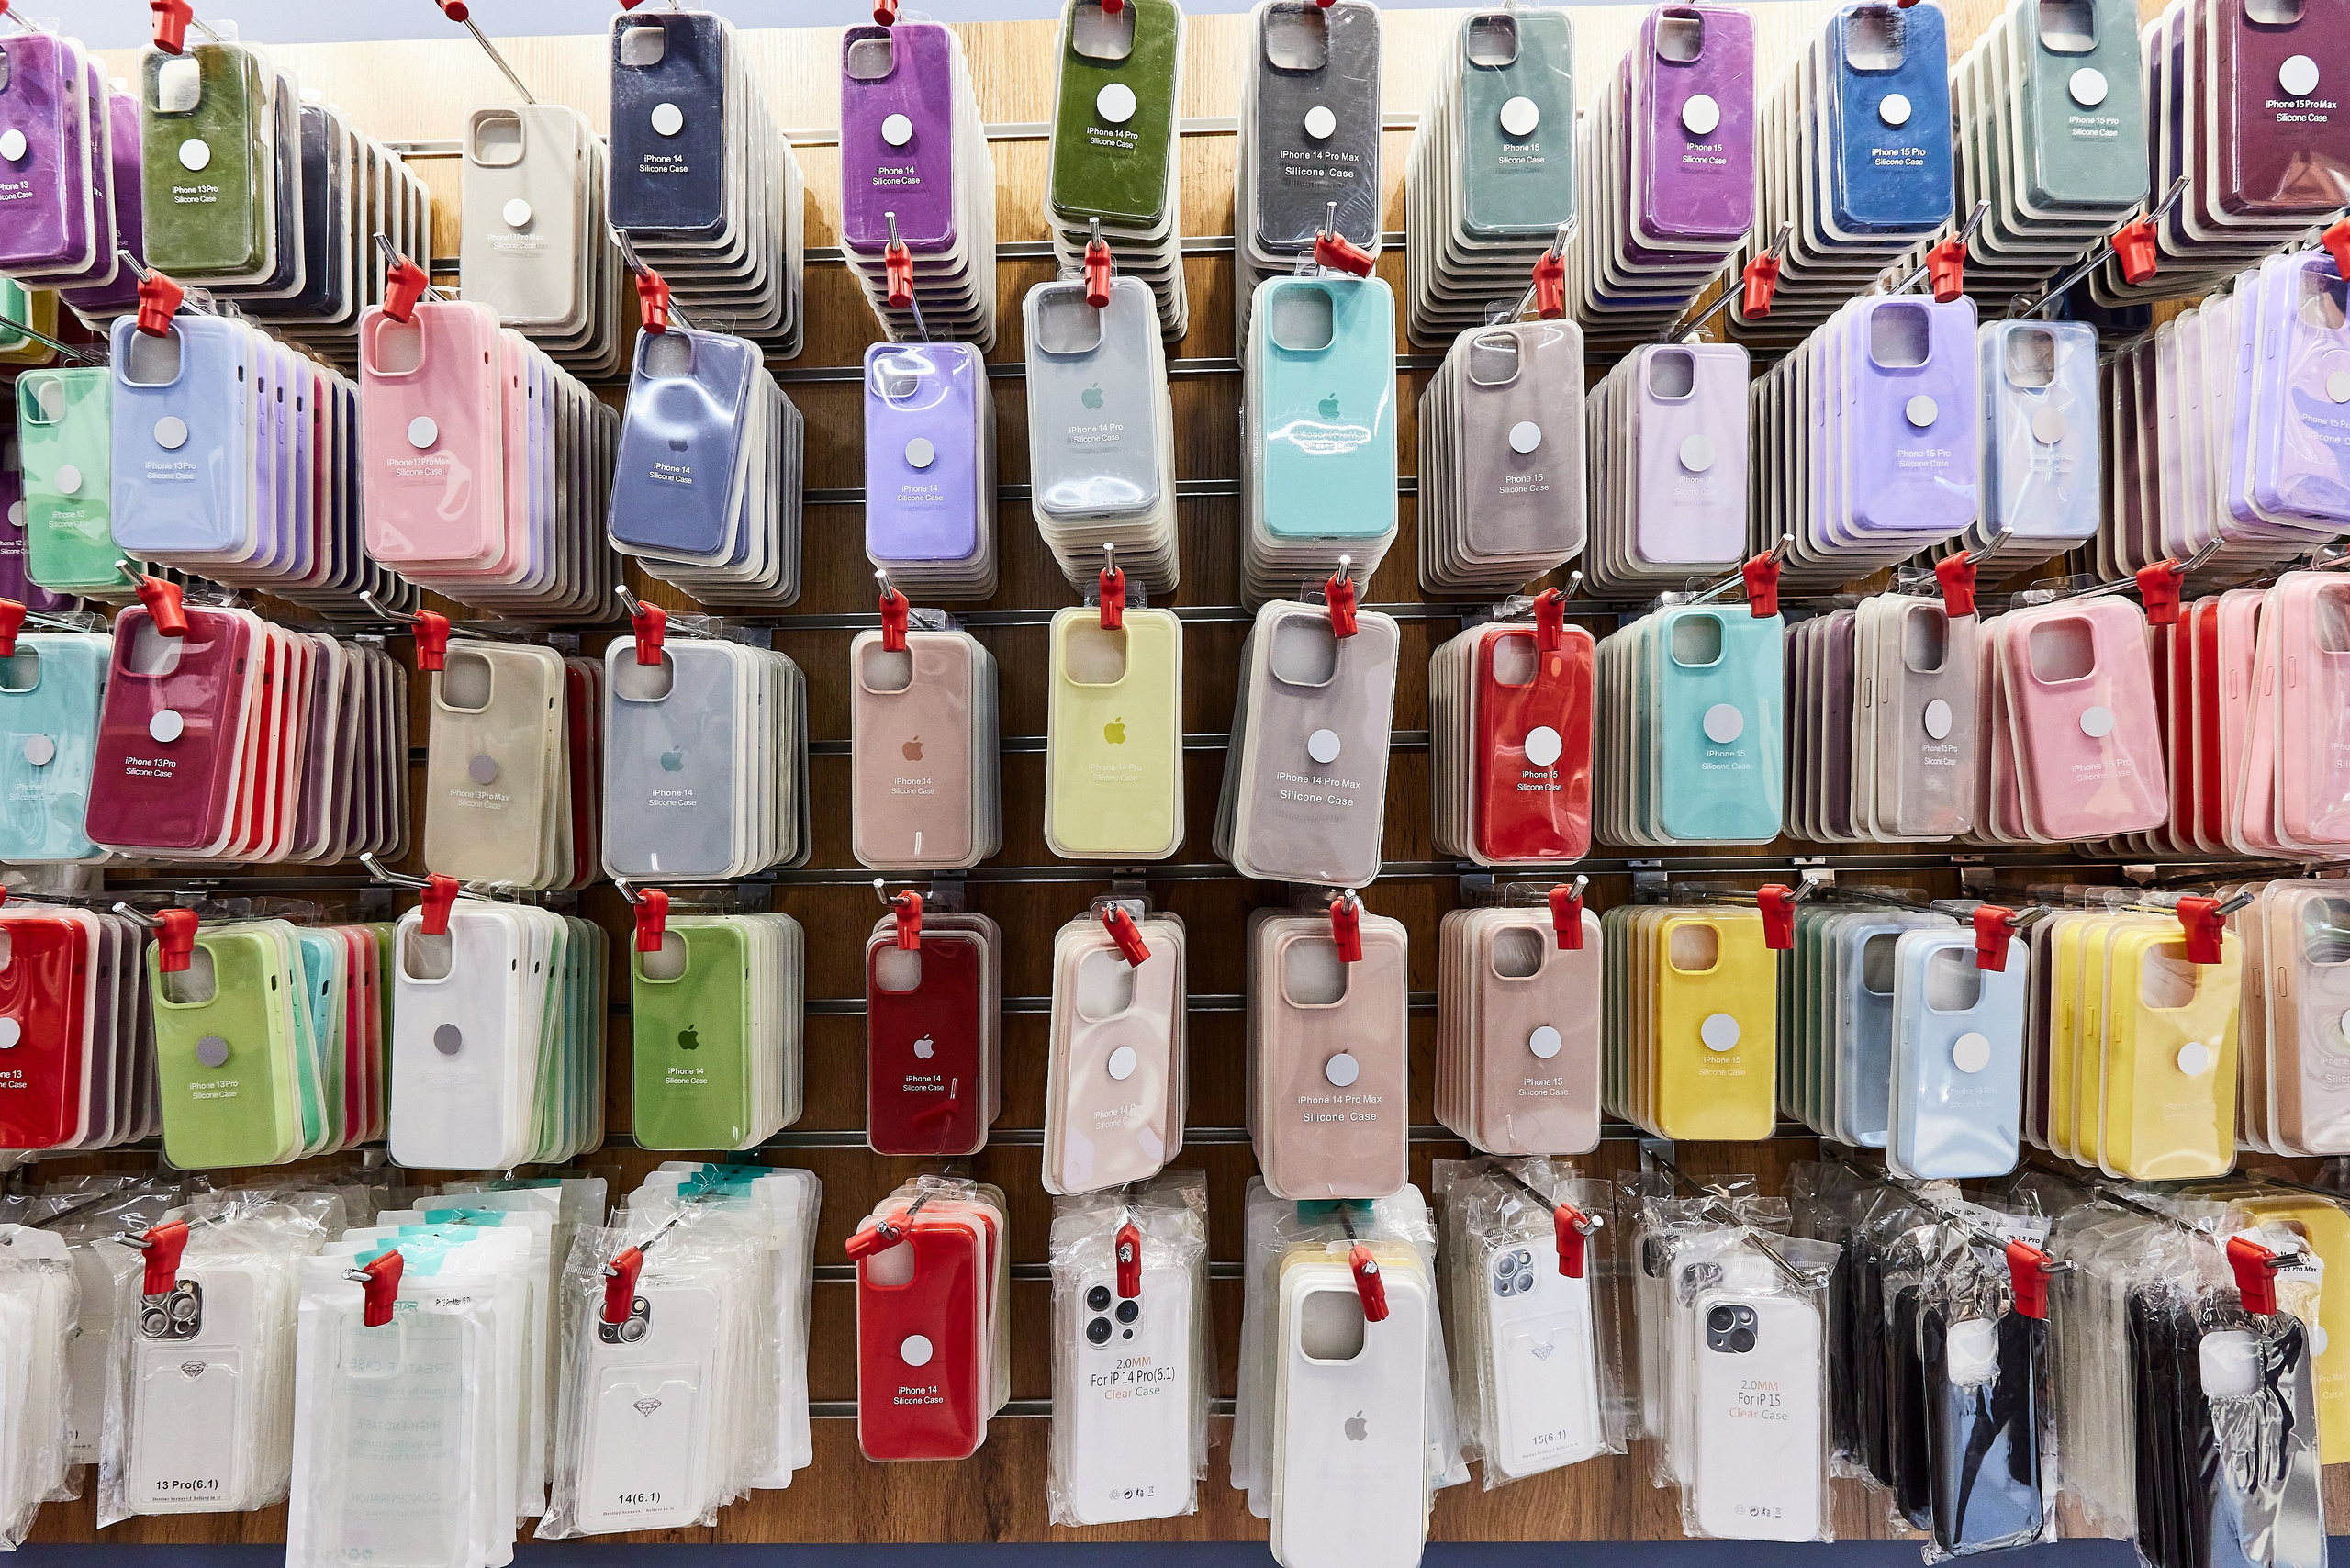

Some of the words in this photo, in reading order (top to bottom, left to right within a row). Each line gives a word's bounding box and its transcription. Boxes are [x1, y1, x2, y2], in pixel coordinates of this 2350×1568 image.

[2069, 116, 2094, 124] iPhone
[2277, 113, 2307, 122] Silicone
[1087, 127, 1113, 137] iPhone
[1125, 131, 1138, 140] Pro
[1091, 138, 1114, 146] Silicone
[1687, 143, 1712, 151] iPhone
[1281, 151, 1310, 159] iPhone
[1313, 151, 1322, 160] 14
[1342, 153, 1359, 162] Max
[1872, 148, 1898, 156] iPhone
[1912, 148, 1926, 156] Pro
[1683, 155, 1707, 163] Silicone
[878, 167, 902, 175] iPhone
[905, 166, 914, 174] 14
[1285, 167, 1324, 176] Silicone
[1329, 169, 1354, 178] Case
[20, 181, 28, 189] 13
[1074, 435, 1102, 443] Silicone
[654, 463, 679, 473] iPhone
[649, 471, 674, 482] Silicone
[676, 476, 692, 484] Case
[1504, 475, 1531, 483] iPhone
[1533, 474, 1543, 482] 15
[1499, 486, 1528, 494] Silicone
[125, 757, 151, 766] iPhone
[1944, 757, 1956, 766] Case
[126, 767, 152, 777] Silicone
[154, 769, 172, 778] Case
[1522, 770, 1548, 778] iPhone
[1276, 771, 1308, 784] iPhone
[1311, 776, 1322, 784] 14
[1325, 777, 1339, 787] Pro
[1342, 779, 1360, 790] Max
[1281, 790, 1322, 802] Silicone
[1328, 796, 1353, 806] Case
[1524, 1078, 1551, 1086] iPhone
[1298, 1096, 1329, 1104] iPhone
[1345, 1095, 1360, 1103] Pro
[1304, 1113, 1344, 1122] Silicone
[1350, 1113, 1376, 1121] Case
[1117, 1356, 1151, 1369] 2.0MM
[1091, 1374, 1107, 1386] For
[1111, 1372, 1119, 1384] iP
[1123, 1371, 1134, 1383] 14
[1137, 1367, 1175, 1383] Pro(6.1)
[898, 1386, 925, 1394] iPhone
[1741, 1380, 1778, 1391] 2.0MM
[1105, 1389, 1132, 1399] Clear
[1136, 1387, 1160, 1396] Case
[1739, 1392, 1754, 1405] For
[1757, 1393, 1766, 1405] iP
[1769, 1394, 1780, 1406] 15
[1729, 1408, 1758, 1417] Clear
[1762, 1410, 1787, 1420] Case
[1533, 1430, 1567, 1445] 15(6.1)
[156, 1481, 168, 1489] 13
[173, 1479, 218, 1491] Pro(6.1)
[619, 1493, 661, 1505] 14(6.1)
